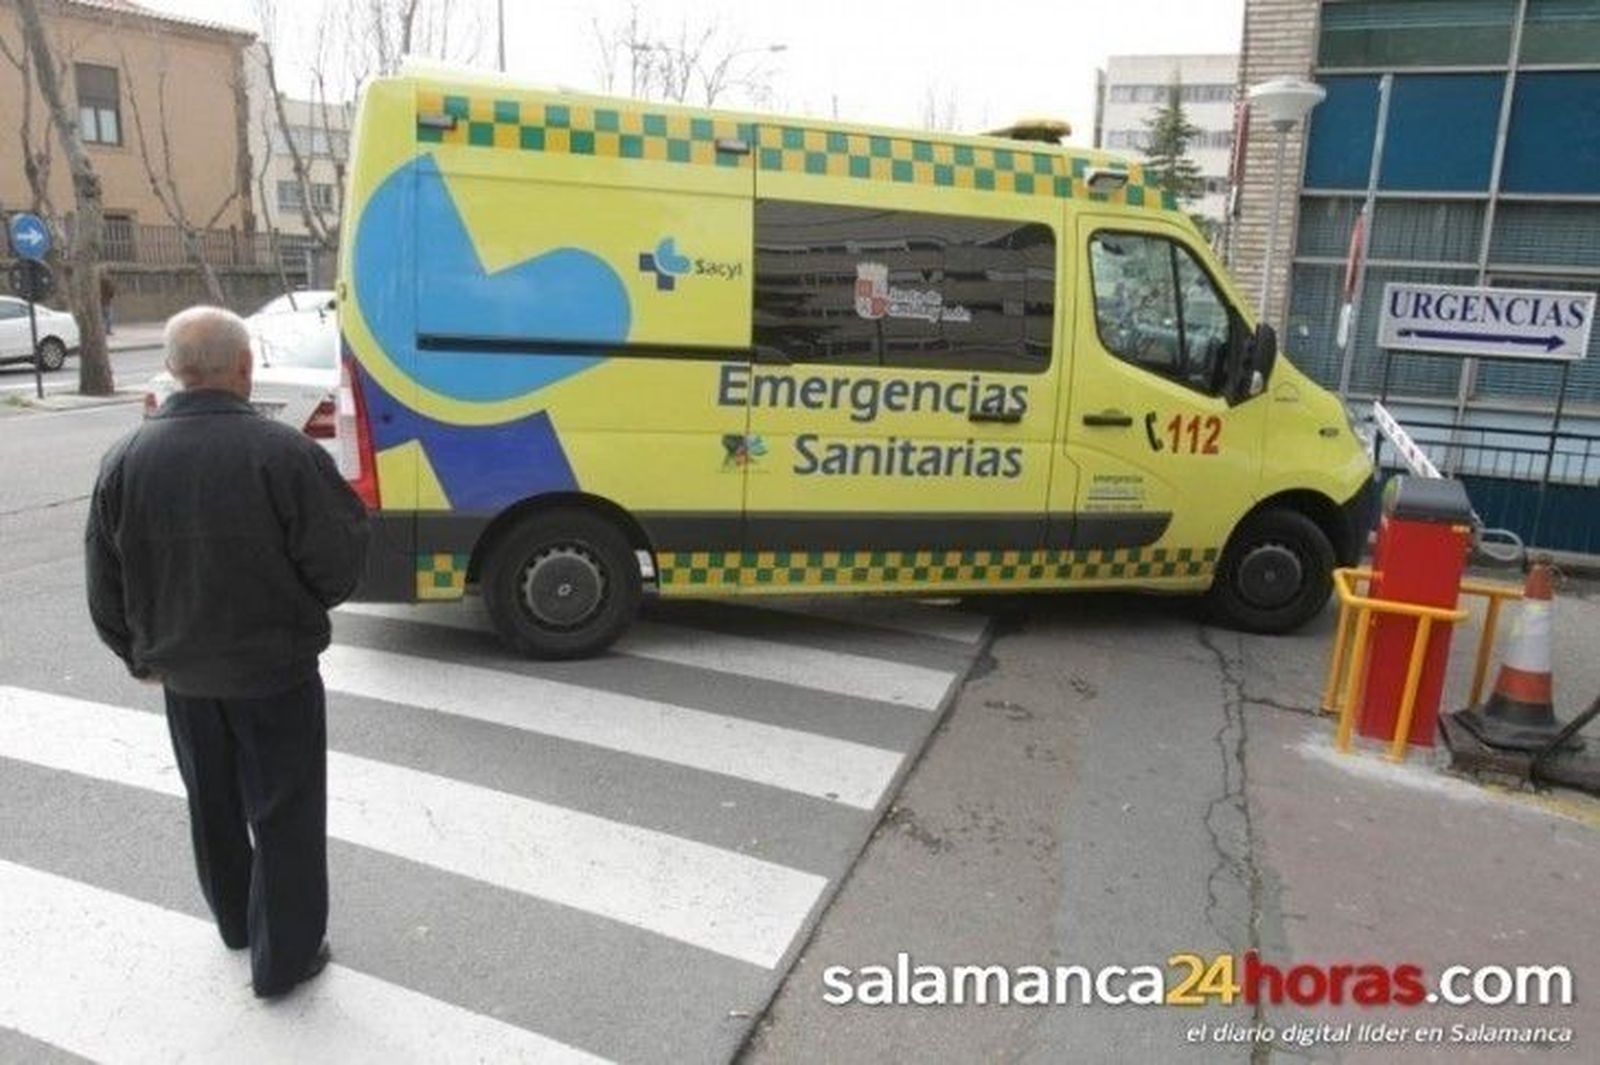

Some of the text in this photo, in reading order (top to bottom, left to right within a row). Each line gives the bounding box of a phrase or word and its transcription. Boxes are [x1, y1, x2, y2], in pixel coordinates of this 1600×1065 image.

[695, 259, 742, 281] Sacyl
[1390, 290, 1586, 329] URGENCIAS
[717, 364, 1029, 422] Emergencias
[1167, 413, 1222, 455] 112
[793, 433, 1023, 478] Sanitarias
